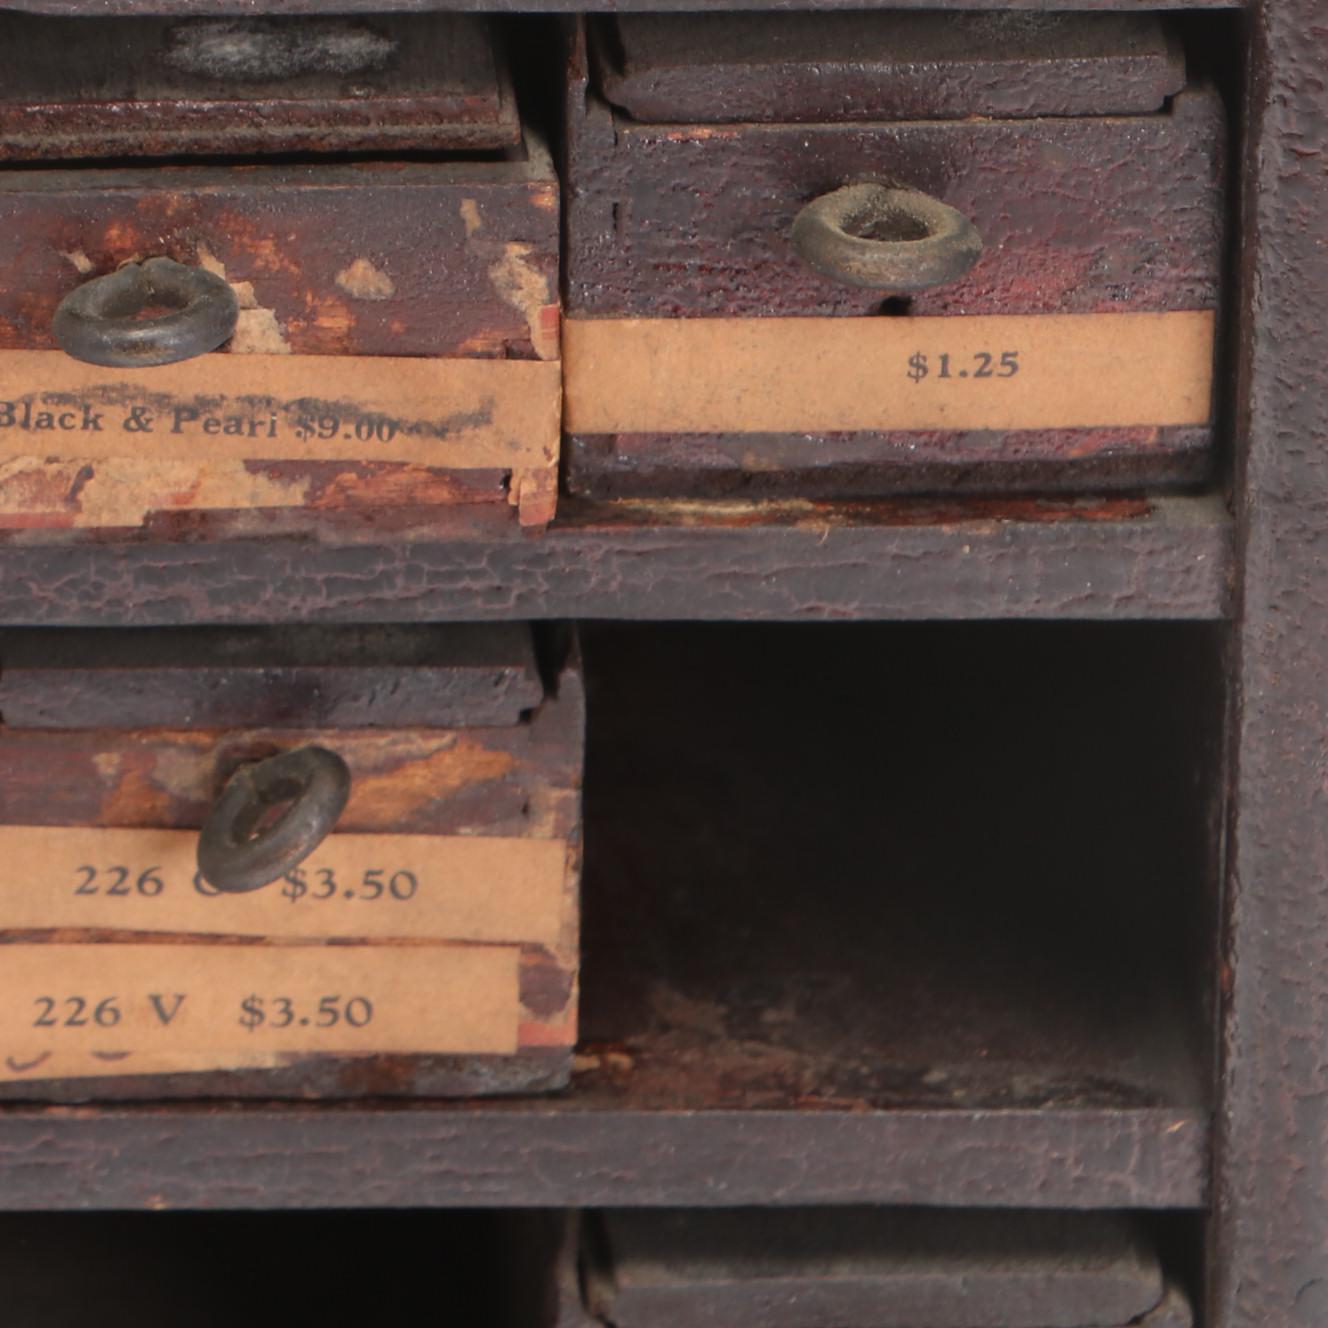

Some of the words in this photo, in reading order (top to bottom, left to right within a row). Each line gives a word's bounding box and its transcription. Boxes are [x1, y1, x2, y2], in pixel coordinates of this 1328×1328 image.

[906, 350, 1019, 385] $1.25
[120, 404, 156, 436] &
[75, 865, 165, 897] 226
[280, 868, 422, 906] $3.50
[33, 996, 122, 1028] 226
[148, 994, 186, 1026] V
[239, 994, 374, 1032] $3.50
